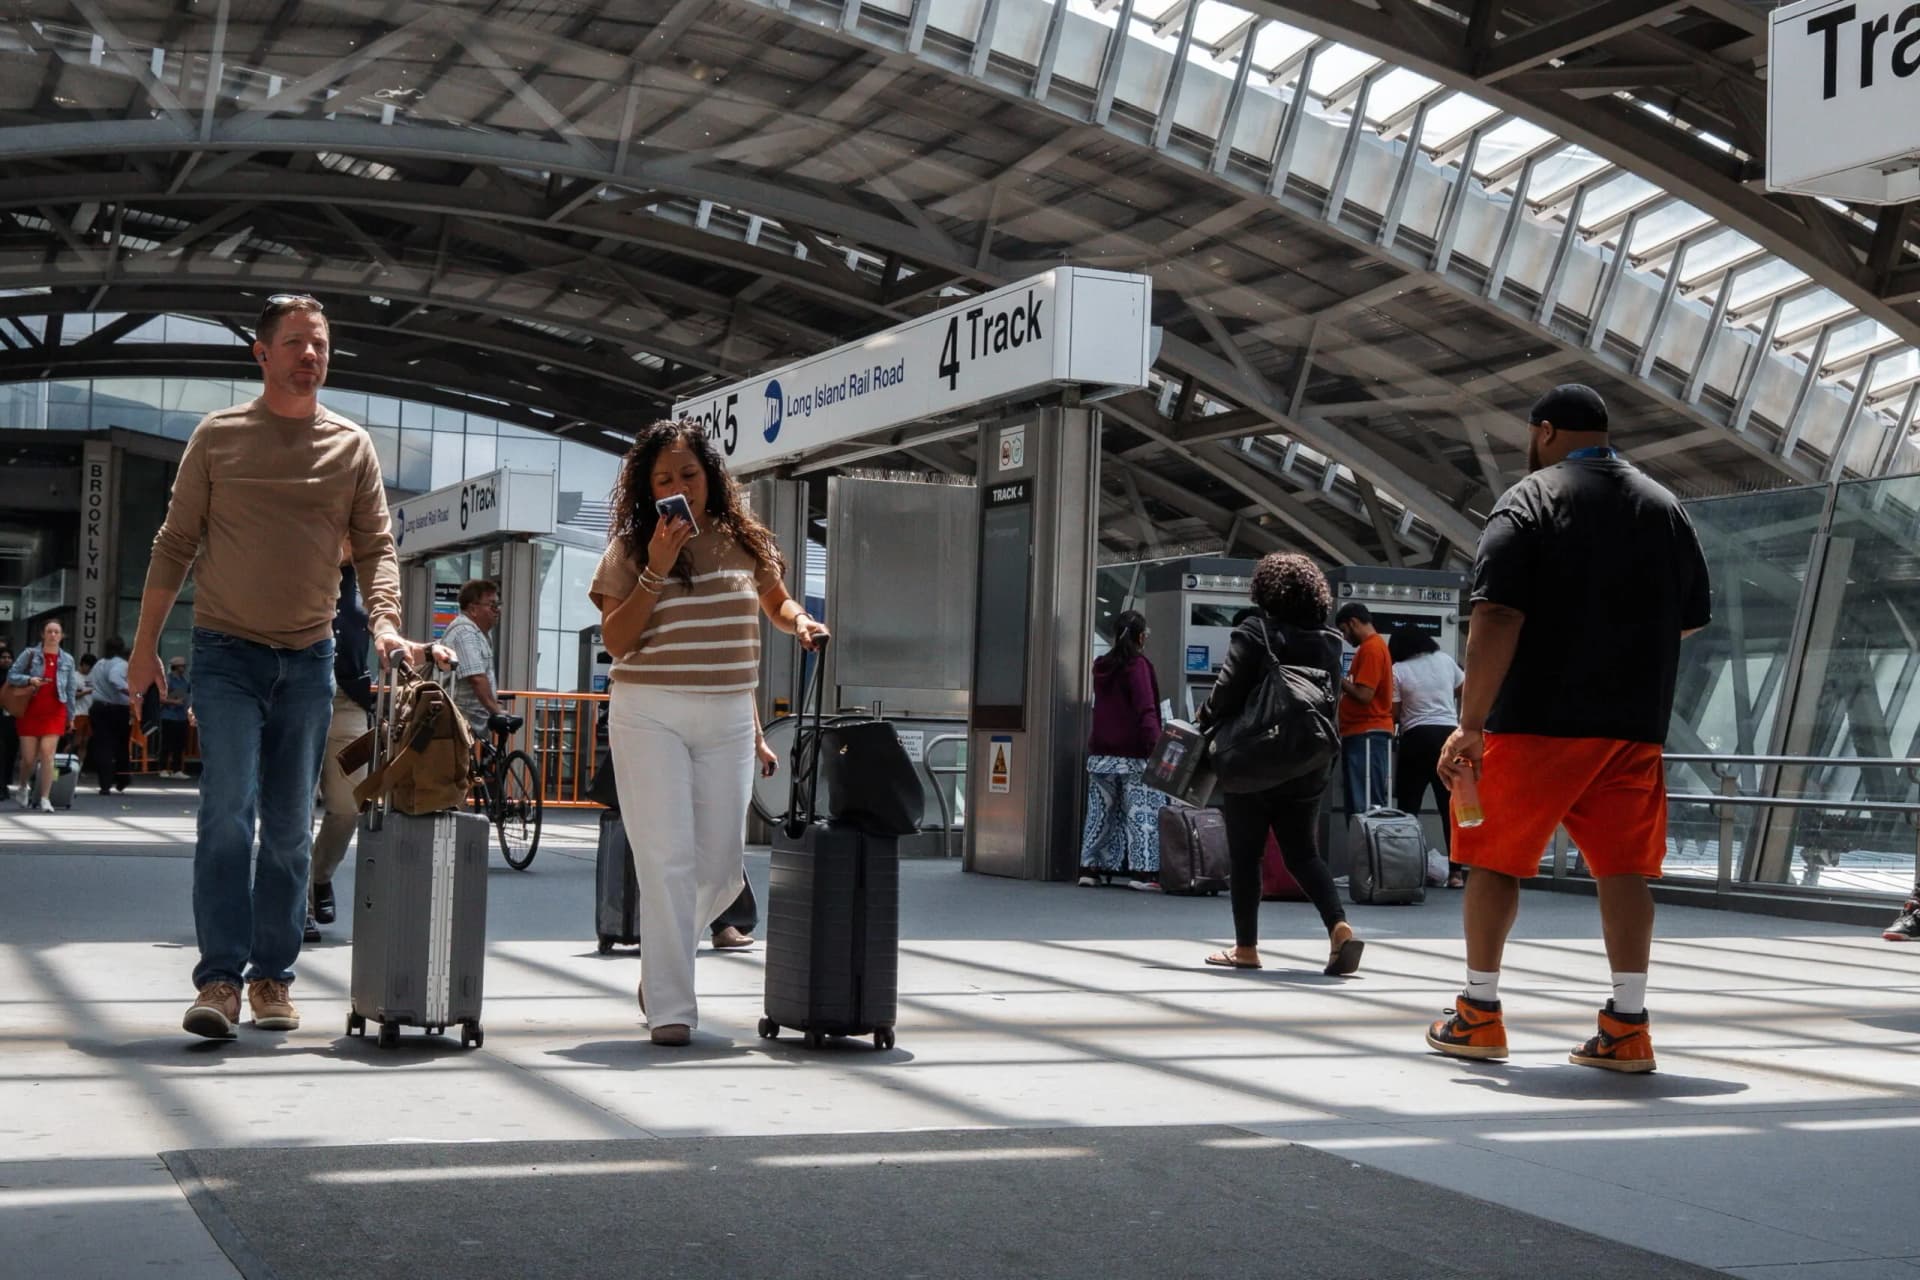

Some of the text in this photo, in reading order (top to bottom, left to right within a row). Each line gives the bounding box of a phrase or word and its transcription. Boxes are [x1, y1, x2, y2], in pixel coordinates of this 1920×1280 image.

[1807, 3, 1920, 100] Tra
[939, 289, 1043, 391] 4 Track
[786, 357, 905, 417] Long Island Rail Road
[678, 393, 739, 456] Tck 5
[86, 464, 103, 580] BROOKLYN
[461, 478, 496, 530] 6 Track
[992, 485, 1023, 502] TRACK 4
[1417, 588, 1451, 602] Tickets
